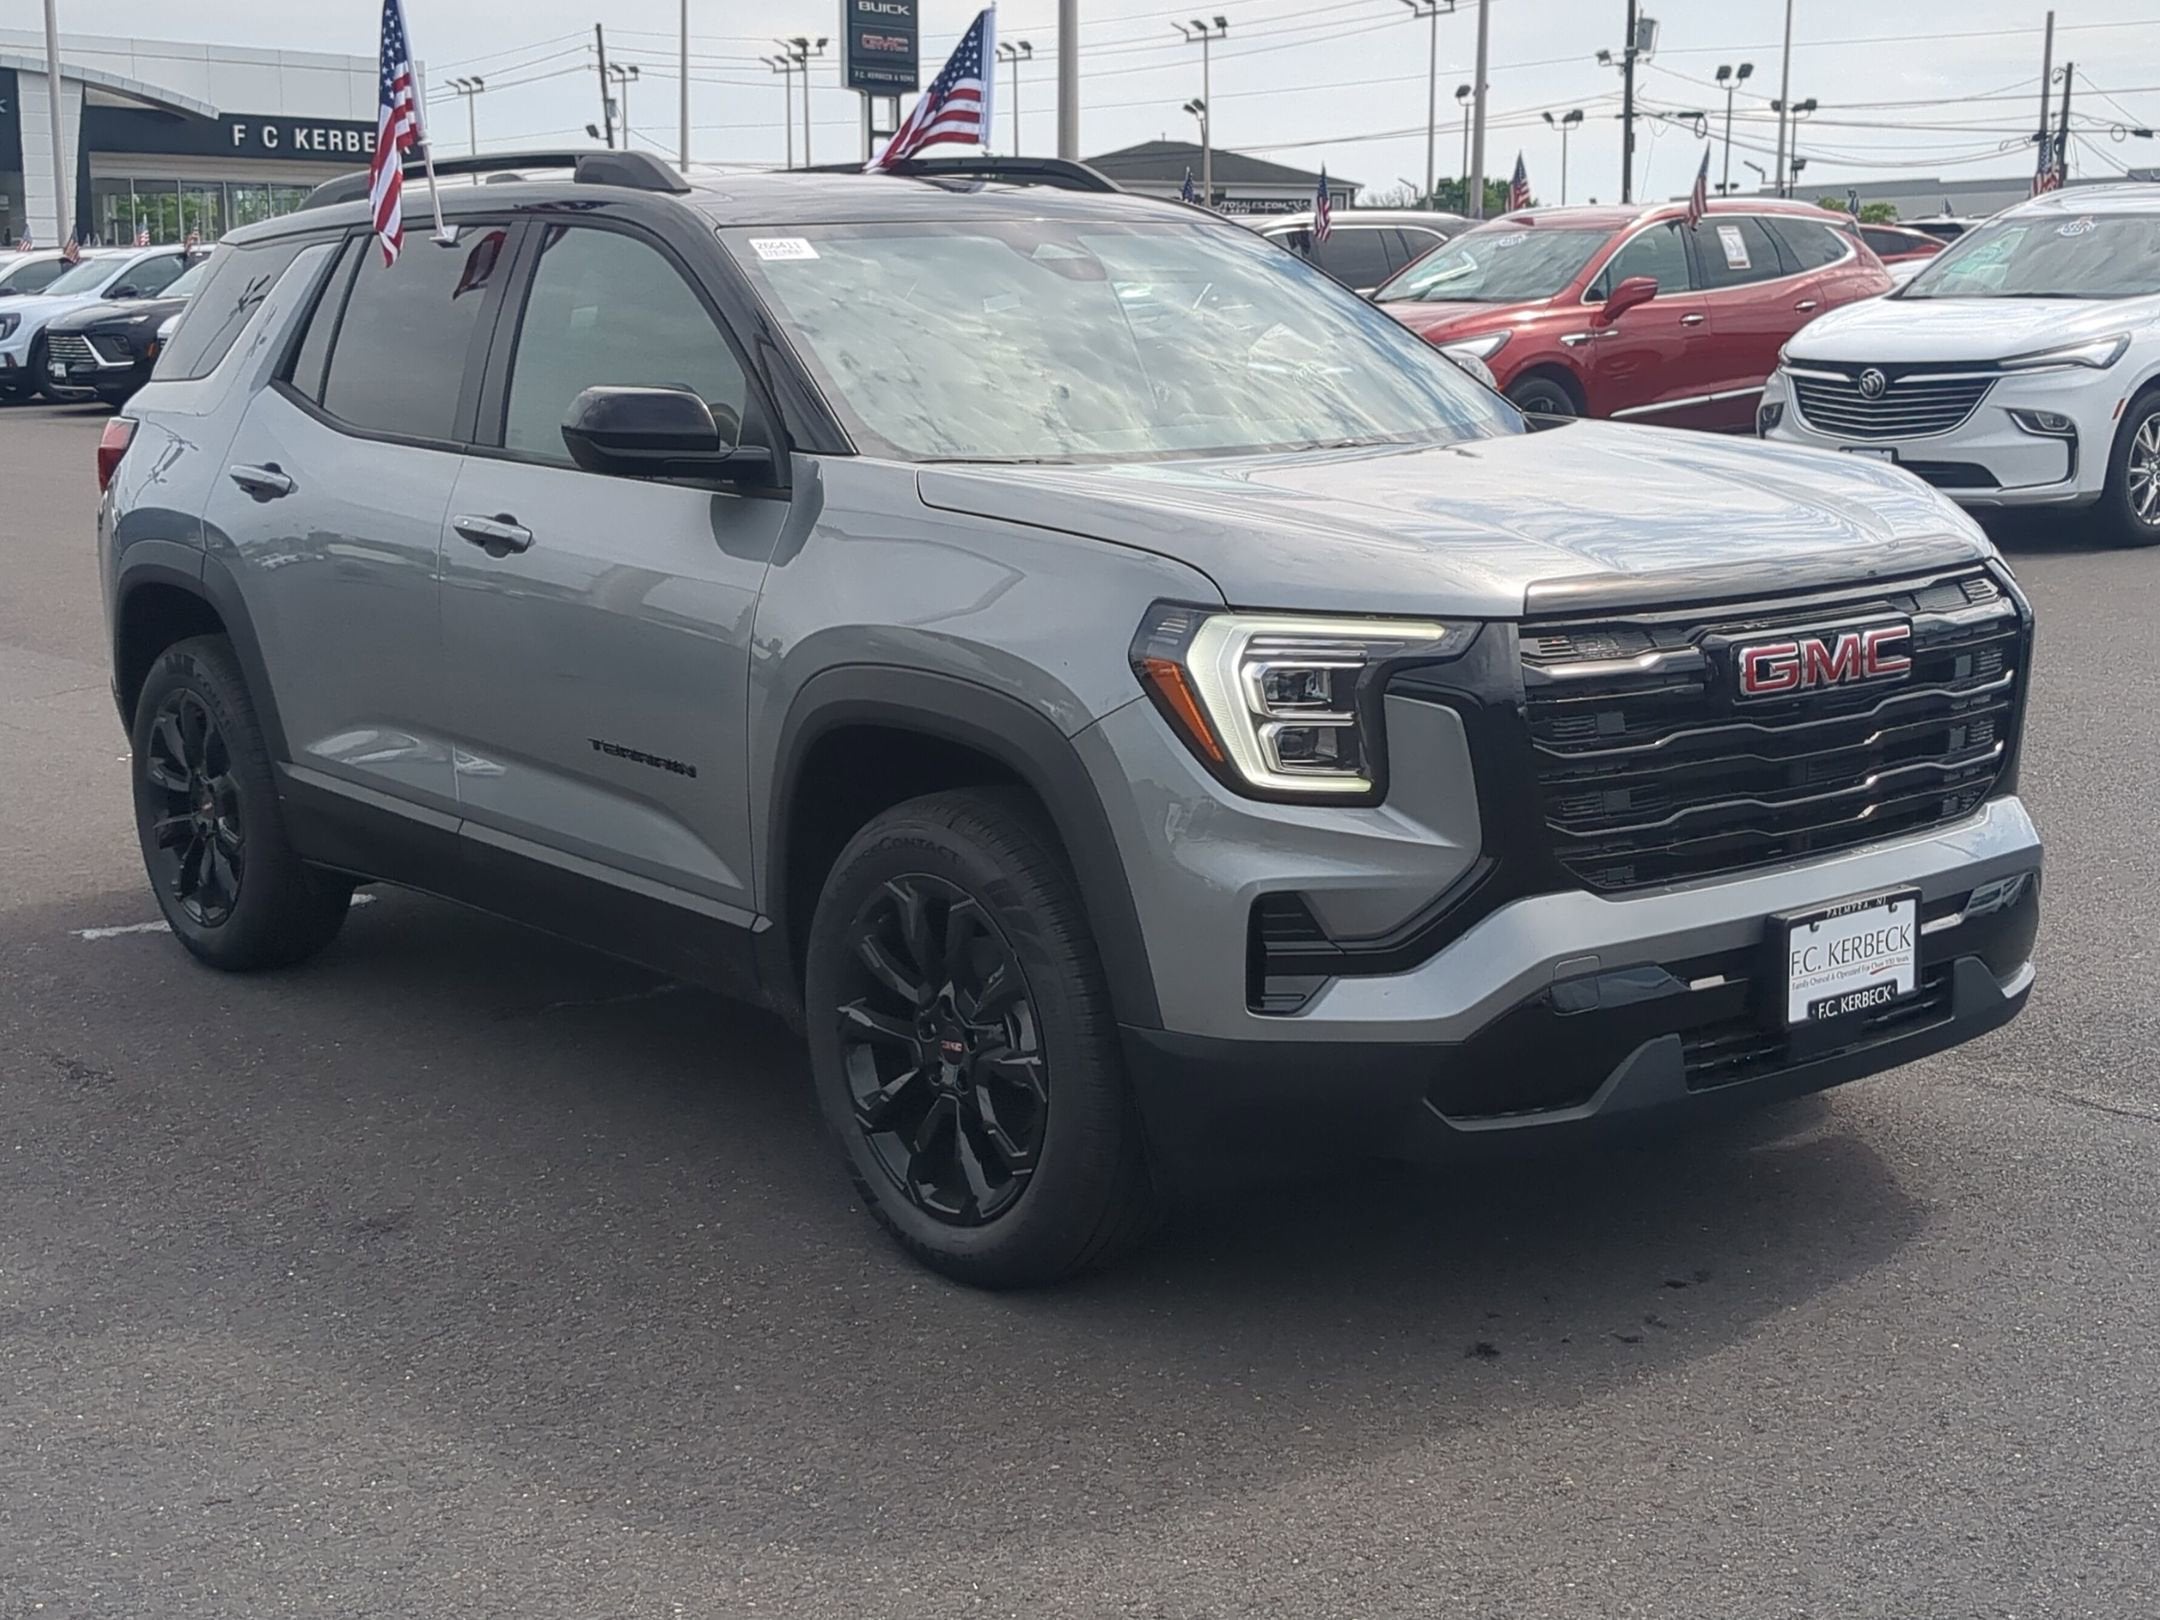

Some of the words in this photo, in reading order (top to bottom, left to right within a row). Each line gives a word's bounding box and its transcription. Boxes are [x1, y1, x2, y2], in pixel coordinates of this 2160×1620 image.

[858, 1, 910, 16] BUICK
[861, 33, 909, 53] GMC
[232, 124, 247, 147] F
[262, 125, 279, 148] C
[294, 127, 410, 155] KERBE
[1738, 624, 1912, 696] GMC
[1790, 946, 1822, 977] F.C.
[1828, 923, 1912, 967] KERBECK
[1818, 1001, 1838, 1019] F.C.
[1841, 985, 1892, 1012] KERBECK
